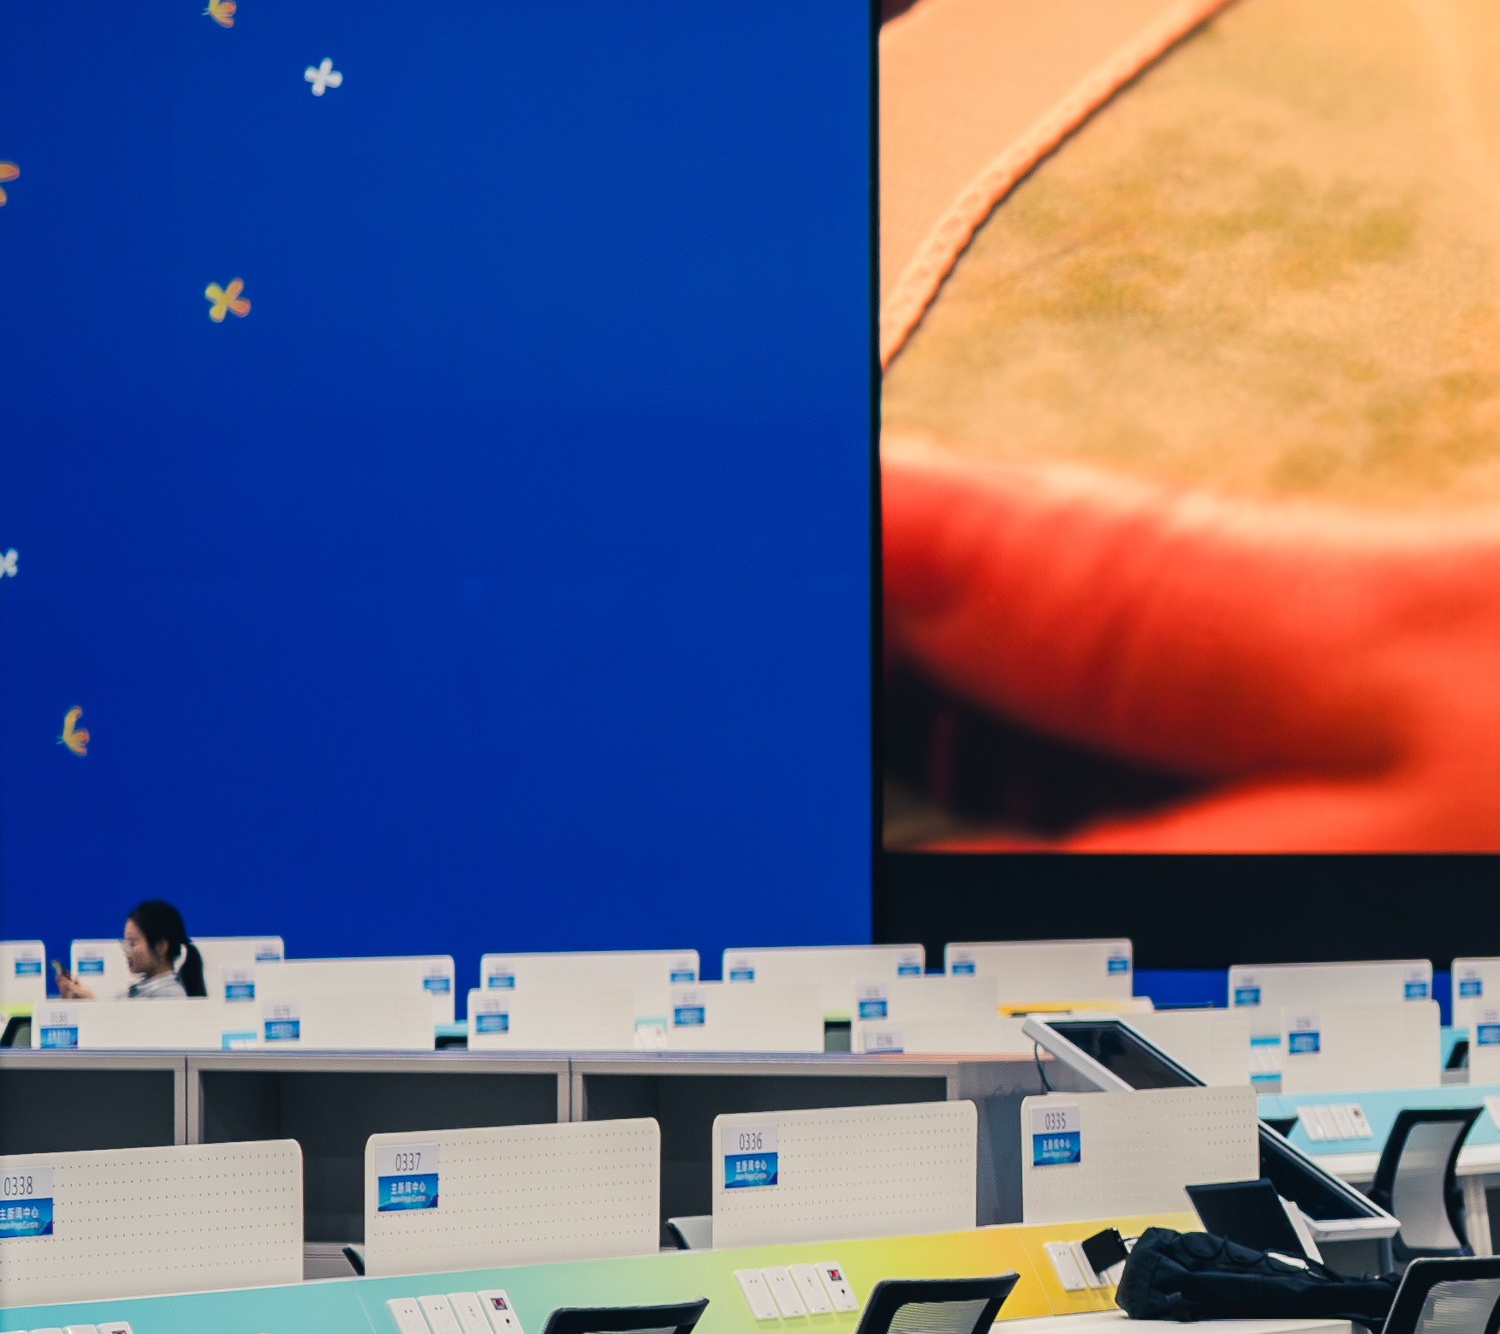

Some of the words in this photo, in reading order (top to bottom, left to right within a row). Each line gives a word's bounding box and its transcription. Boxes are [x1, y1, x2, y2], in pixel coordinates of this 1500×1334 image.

[739, 1132, 762, 1151] 0336
[395, 1152, 421, 1172] 0337
[3, 1175, 33, 1196] 0338
